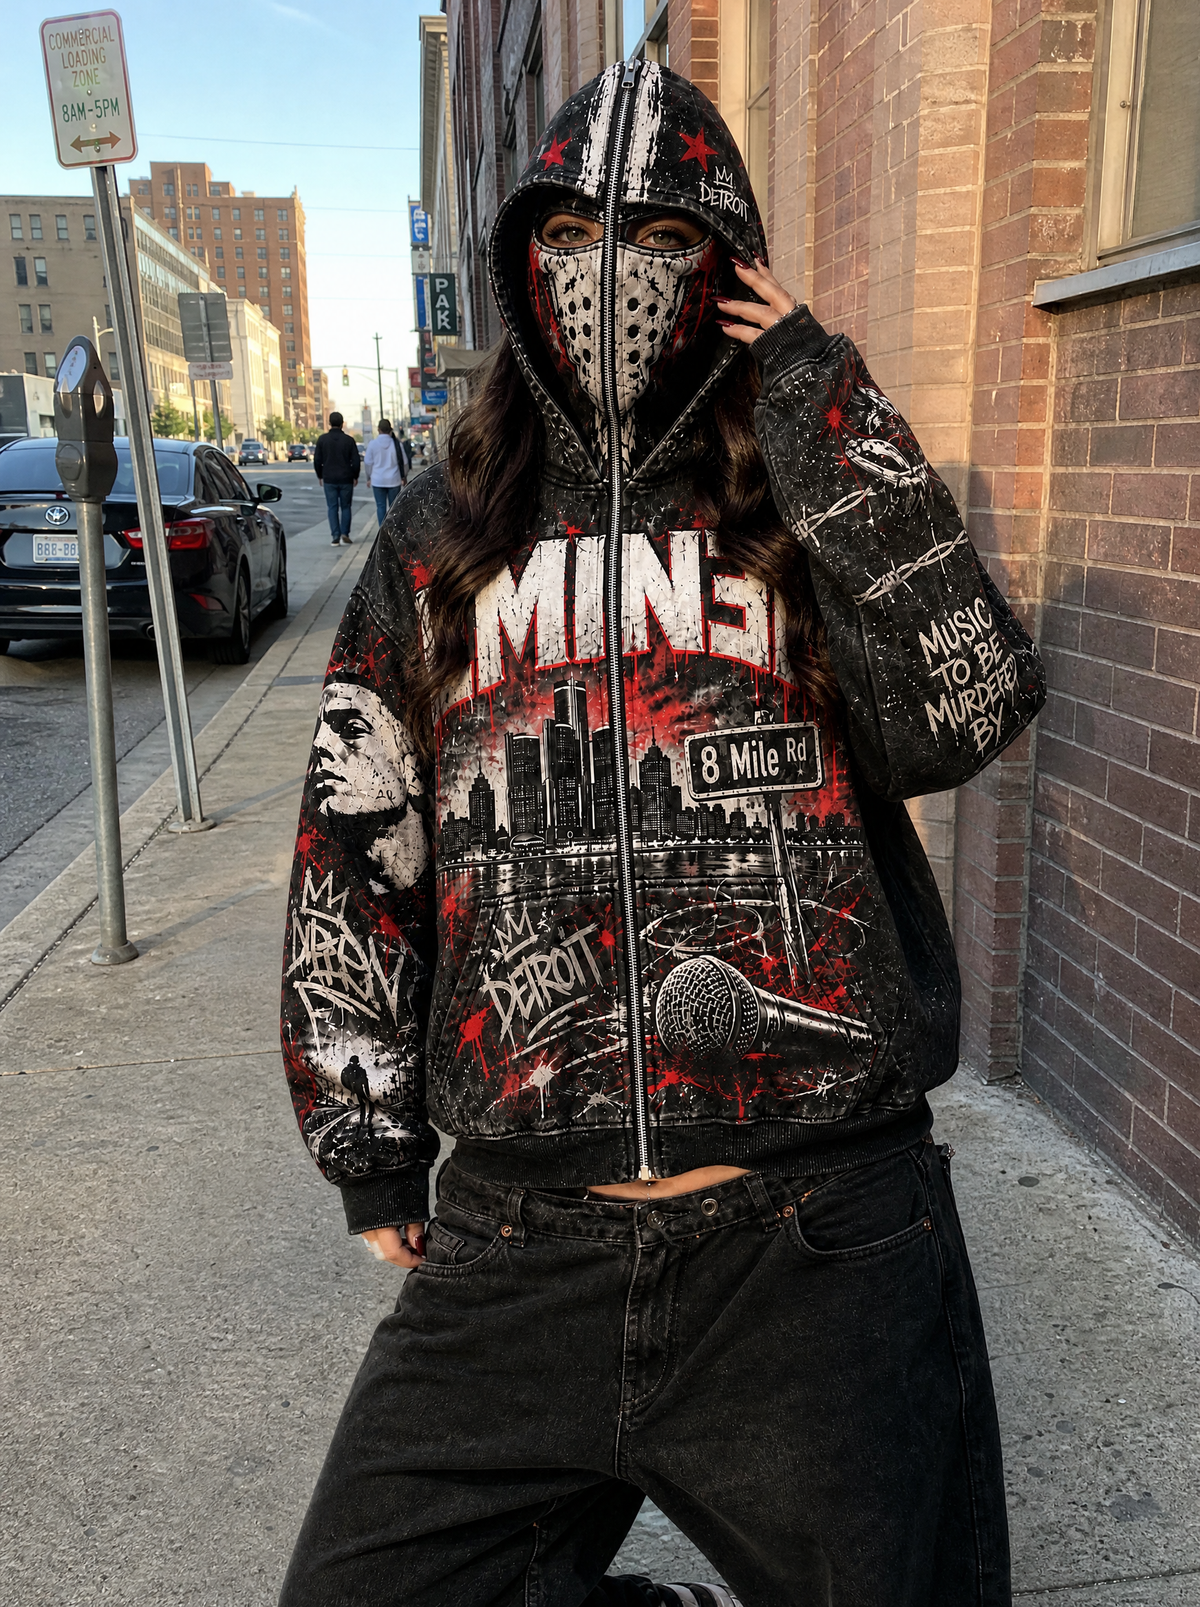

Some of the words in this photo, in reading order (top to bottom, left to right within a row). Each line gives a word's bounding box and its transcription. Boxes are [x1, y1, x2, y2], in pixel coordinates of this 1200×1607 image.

[48, 25, 115, 51] COMMERCIAL
[61, 47, 107, 69] LOADING
[71, 68, 101, 88] ZONE
[61, 97, 120, 123] 8AM-5PM
[699, 181, 749, 222] DETROIT
[435, 278, 452, 330] PAK
[918, 597, 993, 665] MUSIC
[928, 657, 971, 692] TO
[973, 631, 1003, 675] BE
[969, 702, 1004, 753] BY
[700, 745, 720, 784] 8
[729, 739, 780, 781] Mile
[786, 736, 807, 763] Rd
[478, 923, 604, 1044] DETROIT
